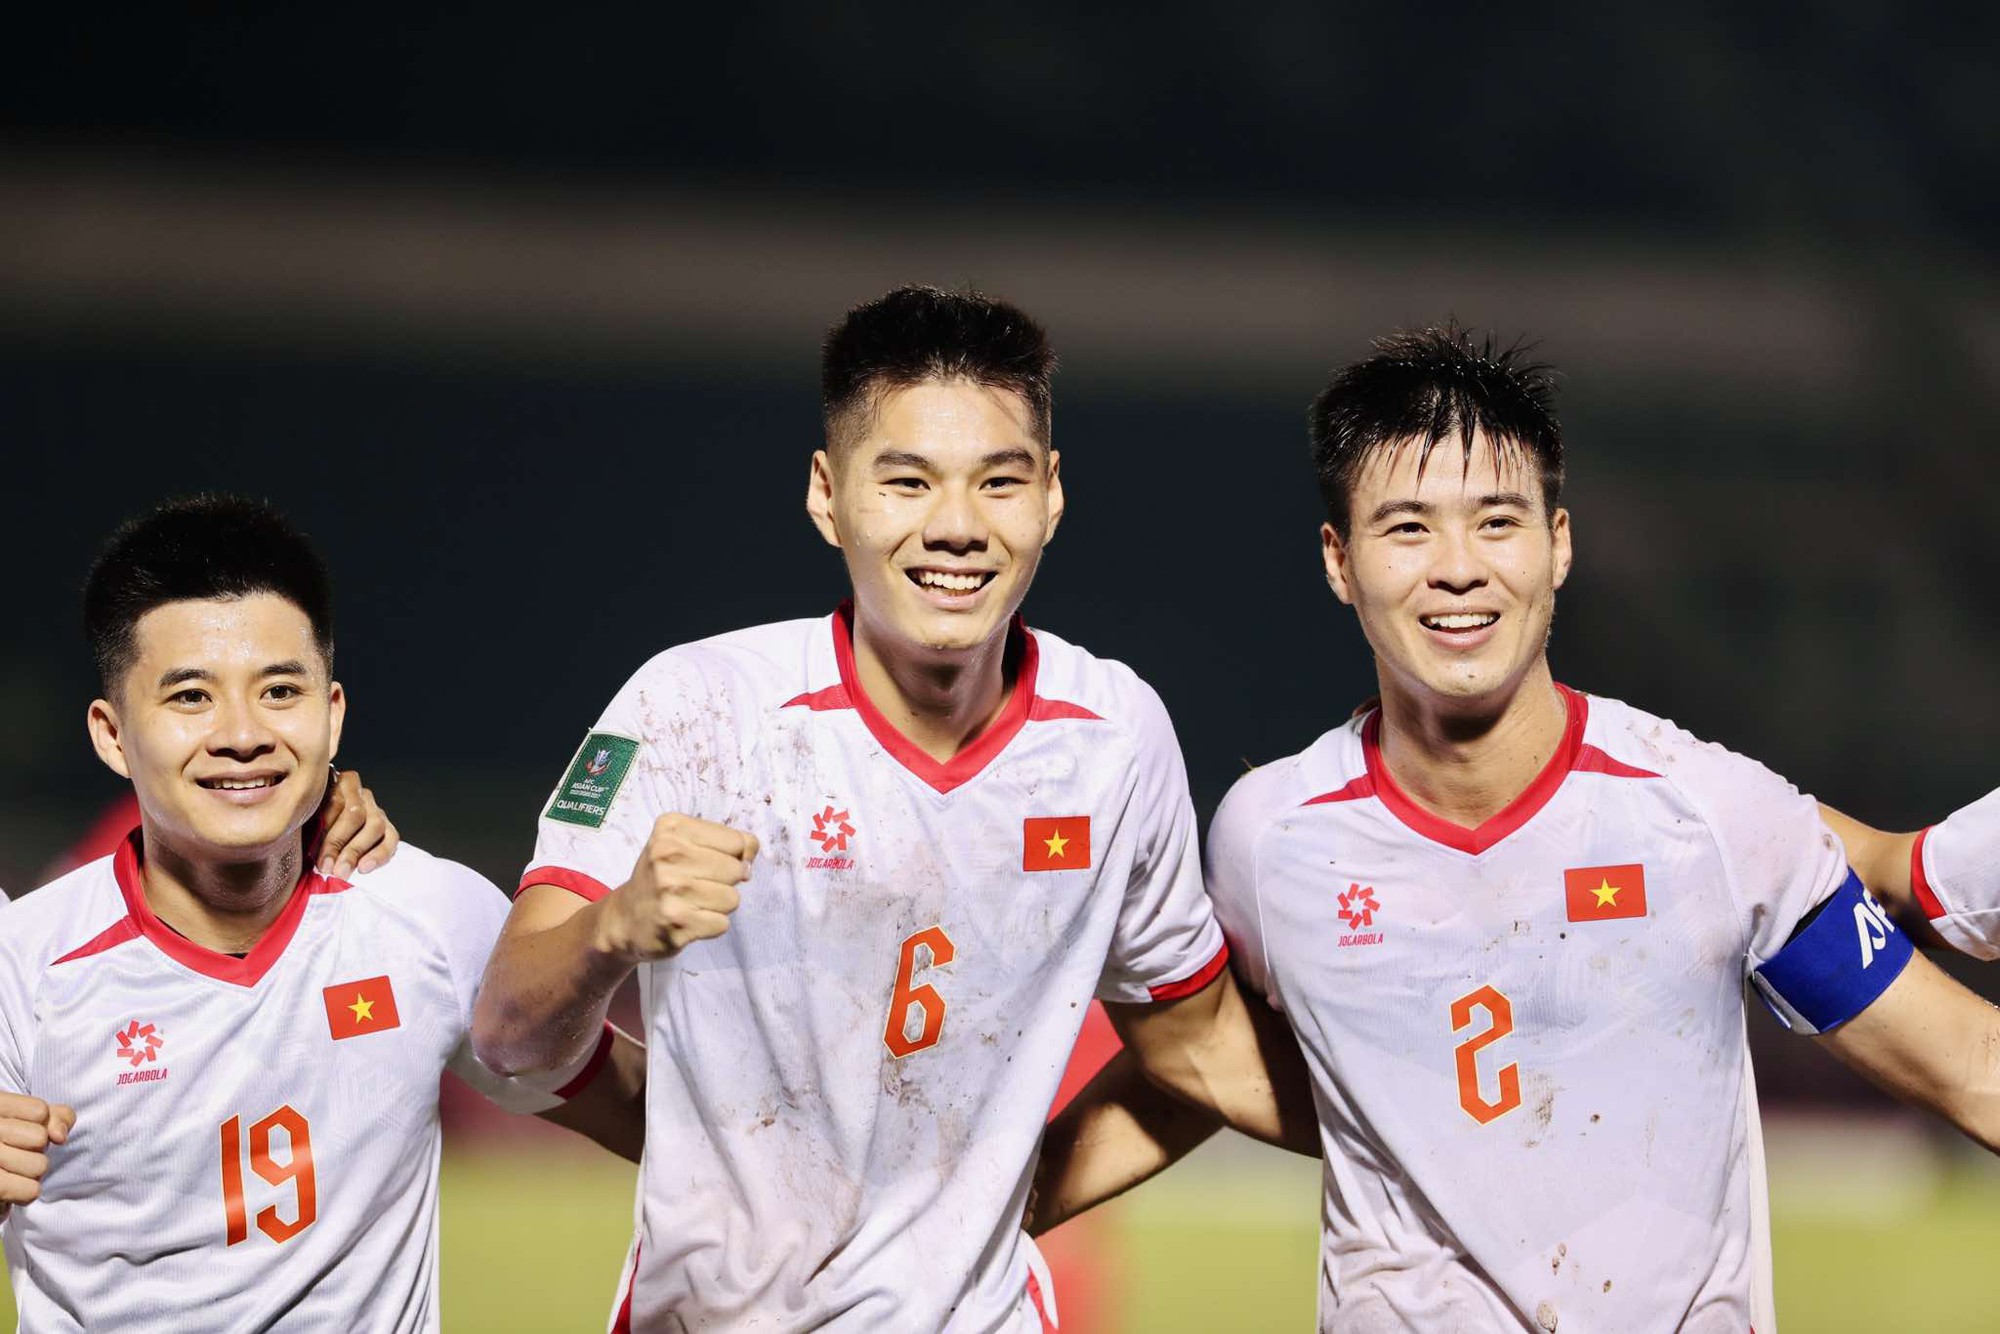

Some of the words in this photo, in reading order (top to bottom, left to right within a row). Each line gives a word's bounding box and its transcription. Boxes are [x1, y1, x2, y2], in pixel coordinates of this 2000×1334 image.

[557, 800, 606, 815] QUALIFIERS
[571, 782, 591, 791] ASIAN
[883, 924, 956, 1060] 6
[117, 1068, 168, 1085] JOGARBOLA
[1450, 984, 1523, 1126] 2
[219, 1104, 318, 1247] 19
